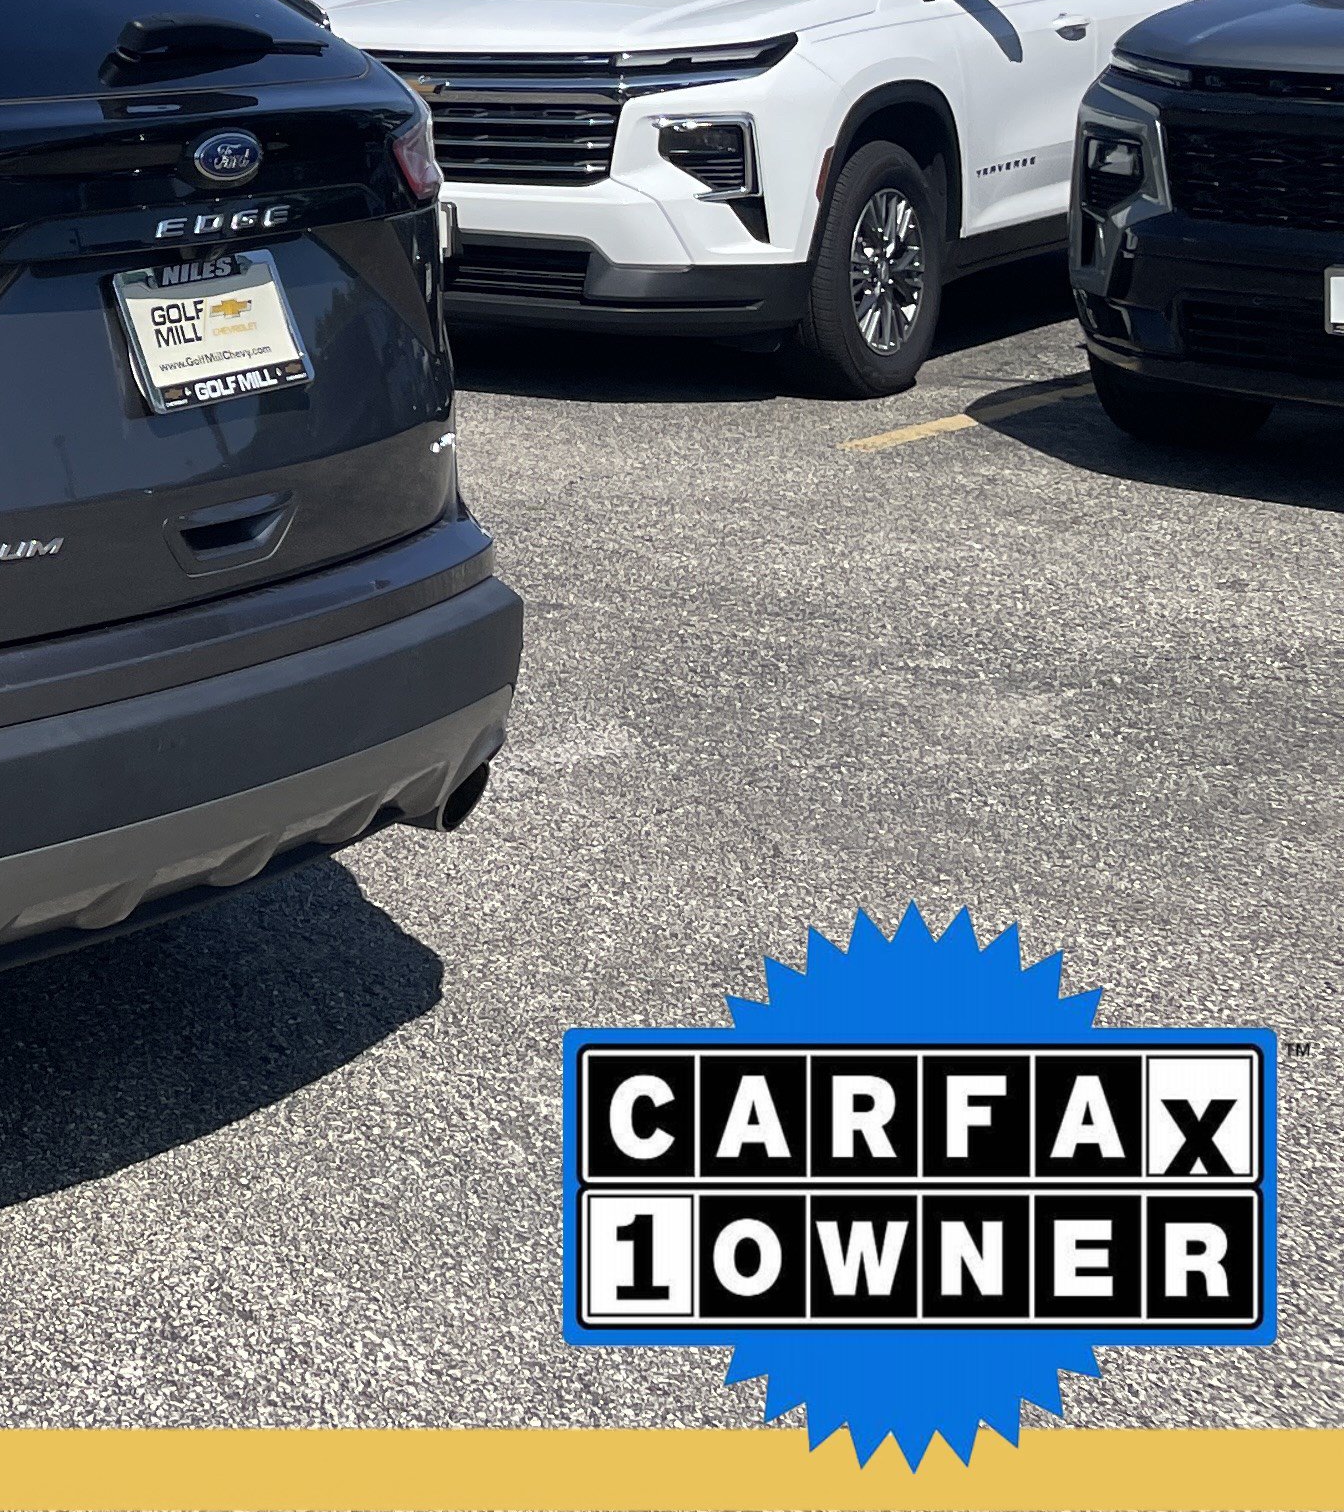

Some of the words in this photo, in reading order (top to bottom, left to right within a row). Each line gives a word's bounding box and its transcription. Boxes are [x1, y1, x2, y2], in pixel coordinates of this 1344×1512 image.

[214, 143, 251, 170] Ford
[156, 205, 290, 238] EDGE
[162, 257, 232, 286] NILES
[150, 299, 205, 326] GOLF
[154, 323, 204, 349] MILL
[158, 344, 272, 372] www.GolfMillChevy.com
[193, 379, 237, 401] GOLF
[236, 368, 279, 393] MILL
